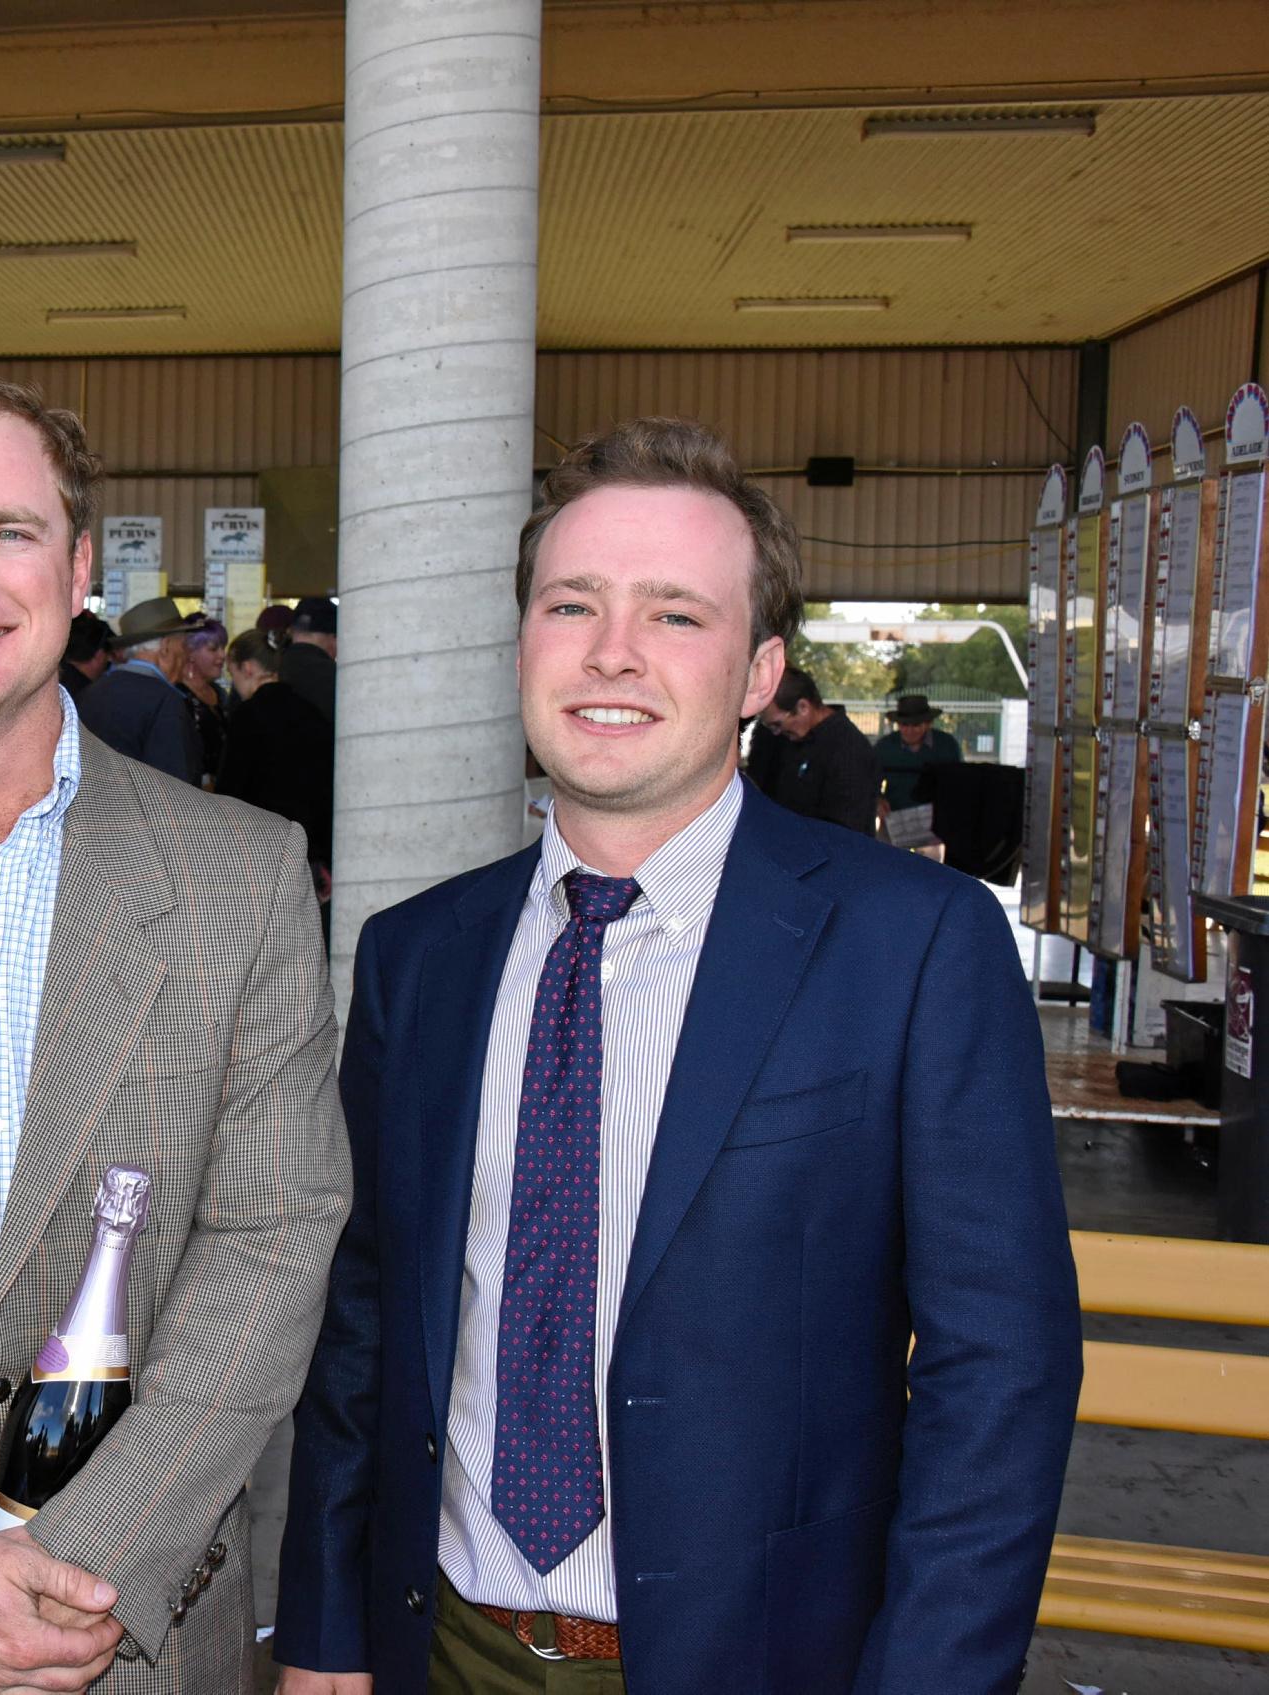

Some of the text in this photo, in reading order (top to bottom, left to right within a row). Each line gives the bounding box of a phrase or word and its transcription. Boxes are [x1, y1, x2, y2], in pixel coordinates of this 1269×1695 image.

[1232, 441, 1262, 456] ADELAIDE
[212, 521, 259, 530] PURVIS
[109, 529, 156, 538] PURVIS
